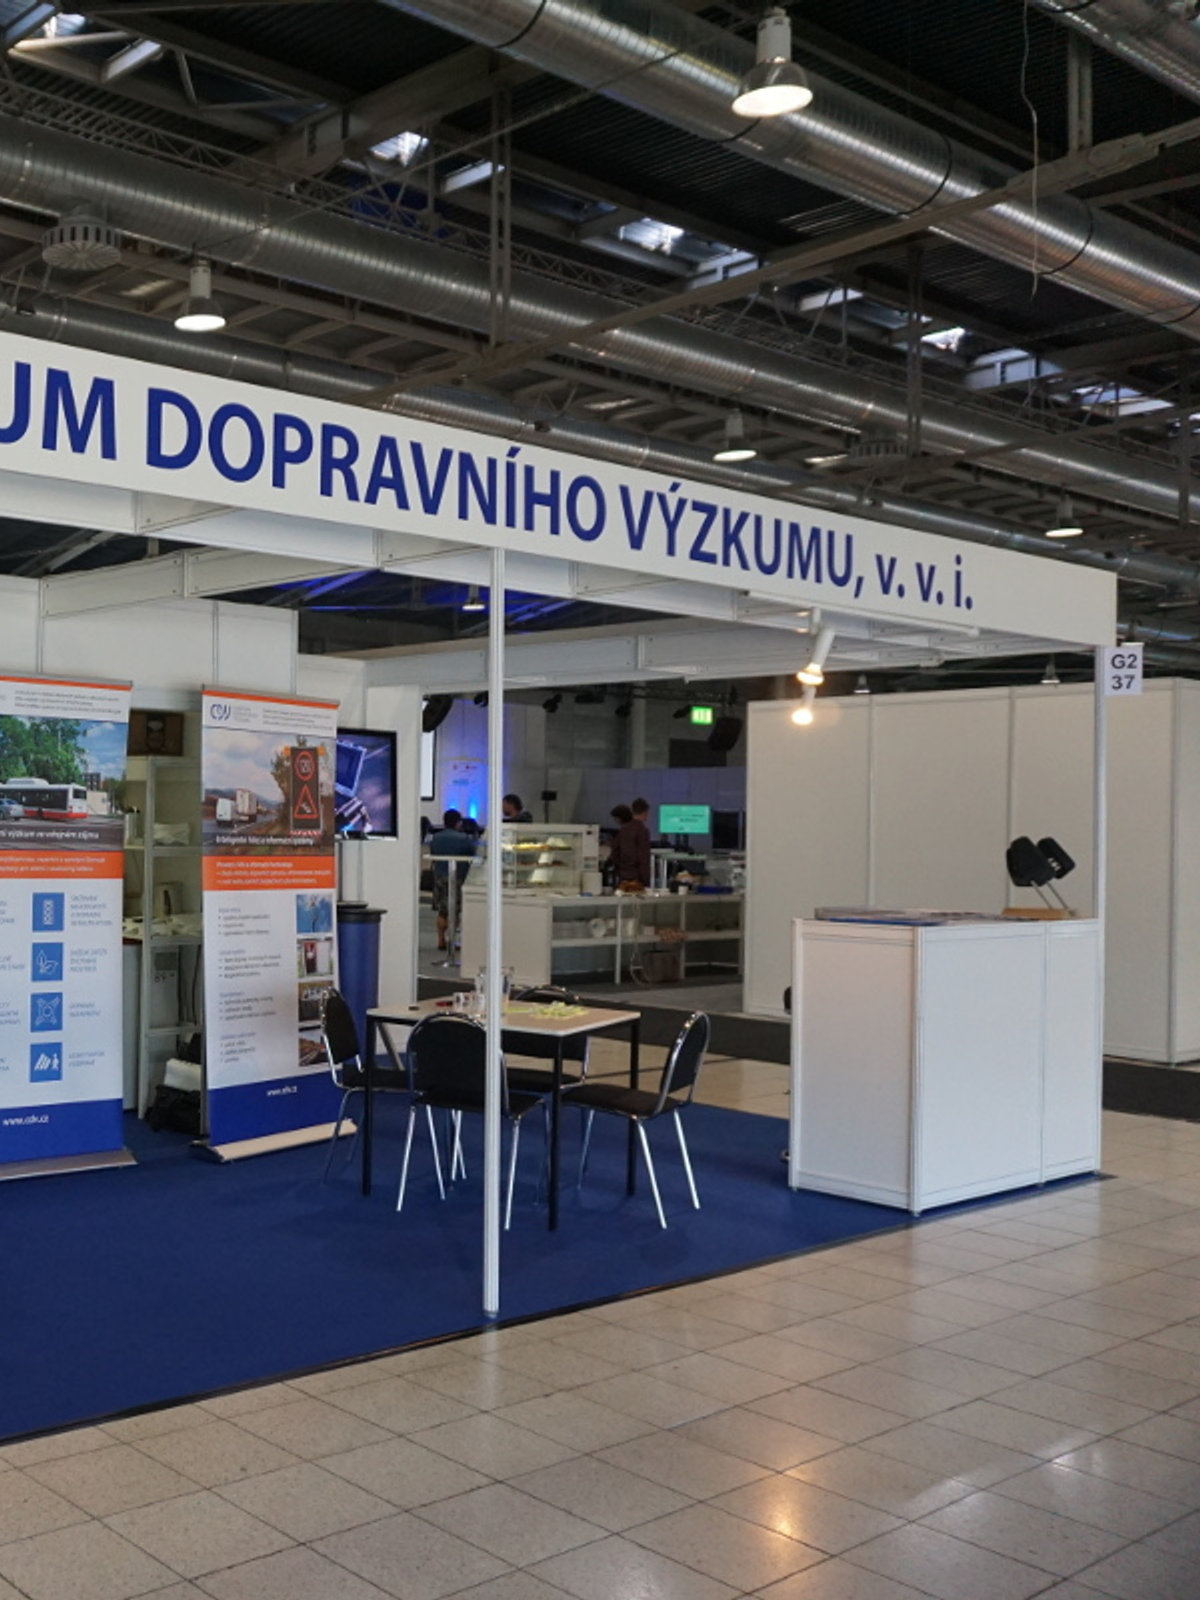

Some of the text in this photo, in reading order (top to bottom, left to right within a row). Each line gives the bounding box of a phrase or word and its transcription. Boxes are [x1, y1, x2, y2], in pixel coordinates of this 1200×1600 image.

[146, 387, 607, 543] DOPRAVNÍHO
[618, 482, 865, 599] VÝZKUMU,
[876, 554, 905, 599] v.
[915, 561, 944, 606] v.
[953, 554, 974, 611] i.
[1111, 653, 1138, 670] G2
[1111, 674, 1135, 690] 37
